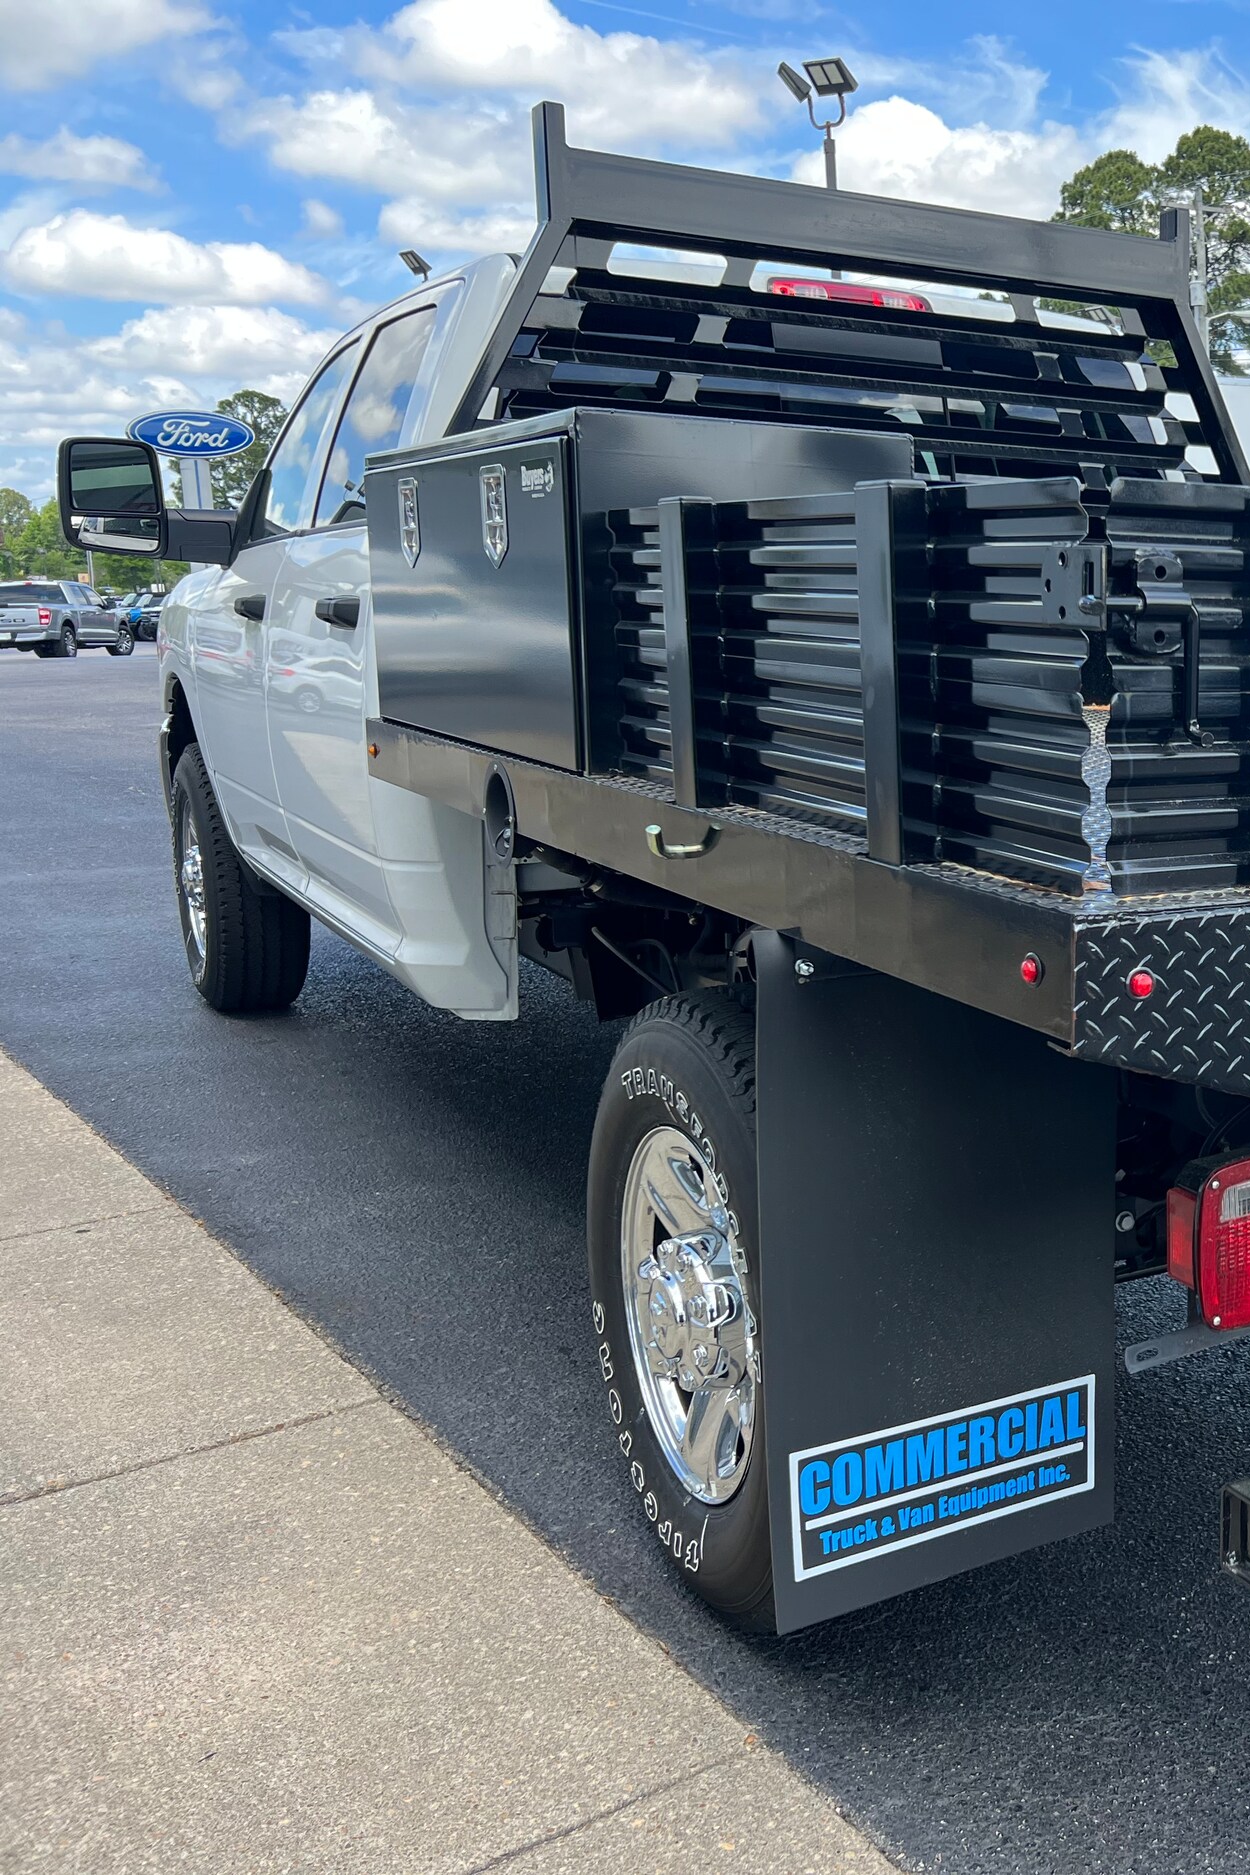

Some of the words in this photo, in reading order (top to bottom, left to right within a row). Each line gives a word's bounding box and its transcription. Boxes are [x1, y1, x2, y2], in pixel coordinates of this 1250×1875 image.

[157, 419, 229, 448] Ford
[800, 1391, 1086, 1515] COMMERCIAL
[819, 1518, 878, 1555] Truck
[880, 1516, 896, 1537] &
[897, 1502, 934, 1531] Van
[938, 1468, 1036, 1517] Equipment
[1038, 1463, 1071, 1488] Inc.
